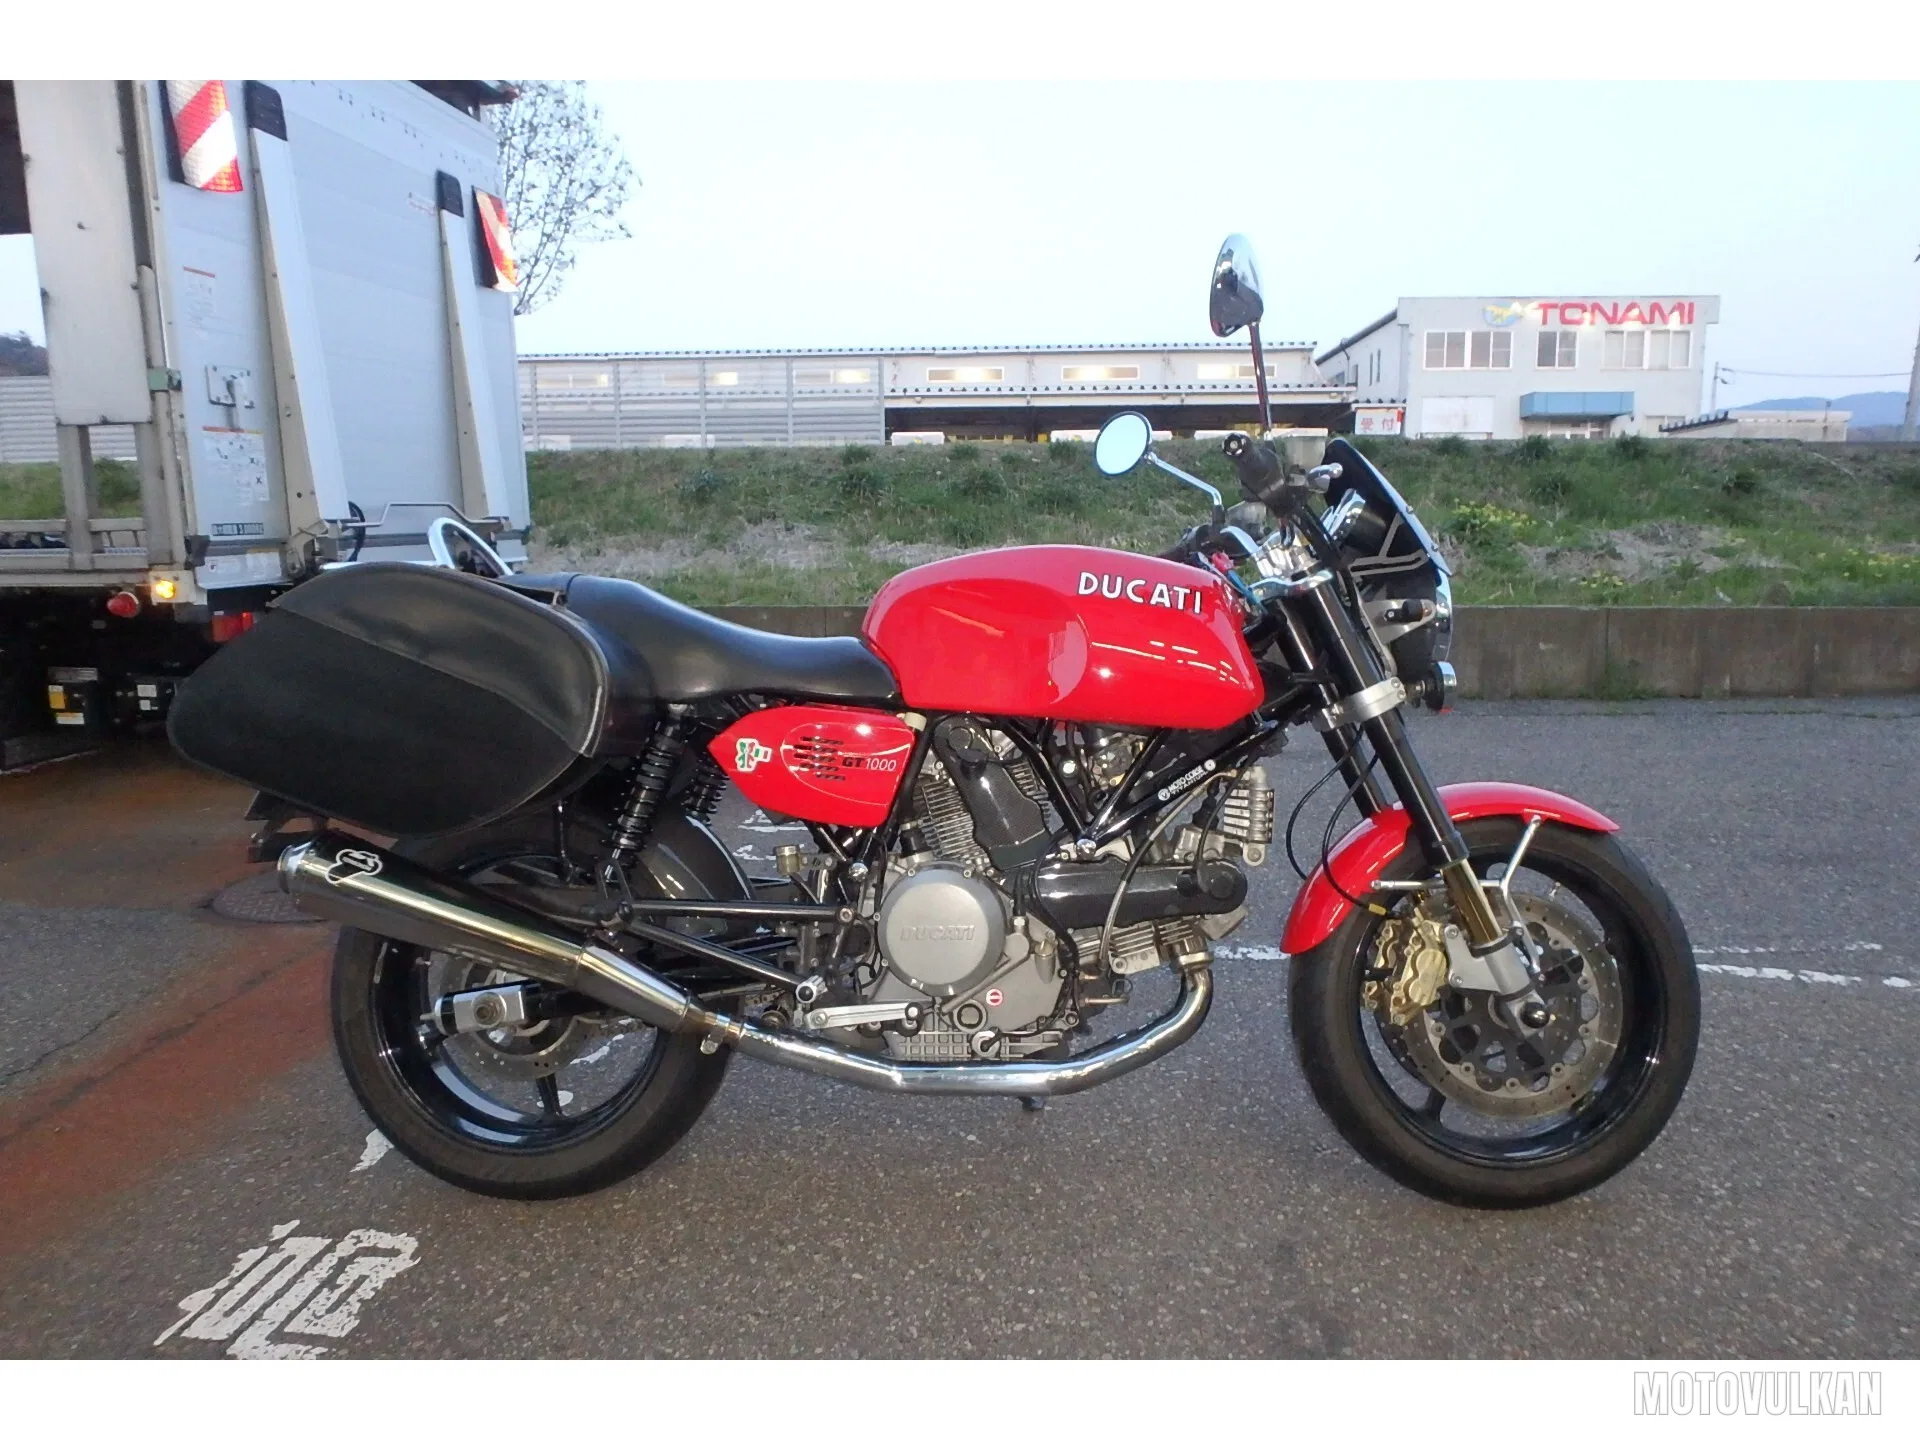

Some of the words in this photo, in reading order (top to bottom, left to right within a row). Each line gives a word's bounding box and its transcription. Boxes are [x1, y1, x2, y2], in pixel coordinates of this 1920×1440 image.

[1537, 301, 1695, 326] TONAMI
[1078, 571, 1203, 615] DUCATI
[1168, 776, 1187, 793] MOTO
[900, 924, 976, 941] DUCATI
